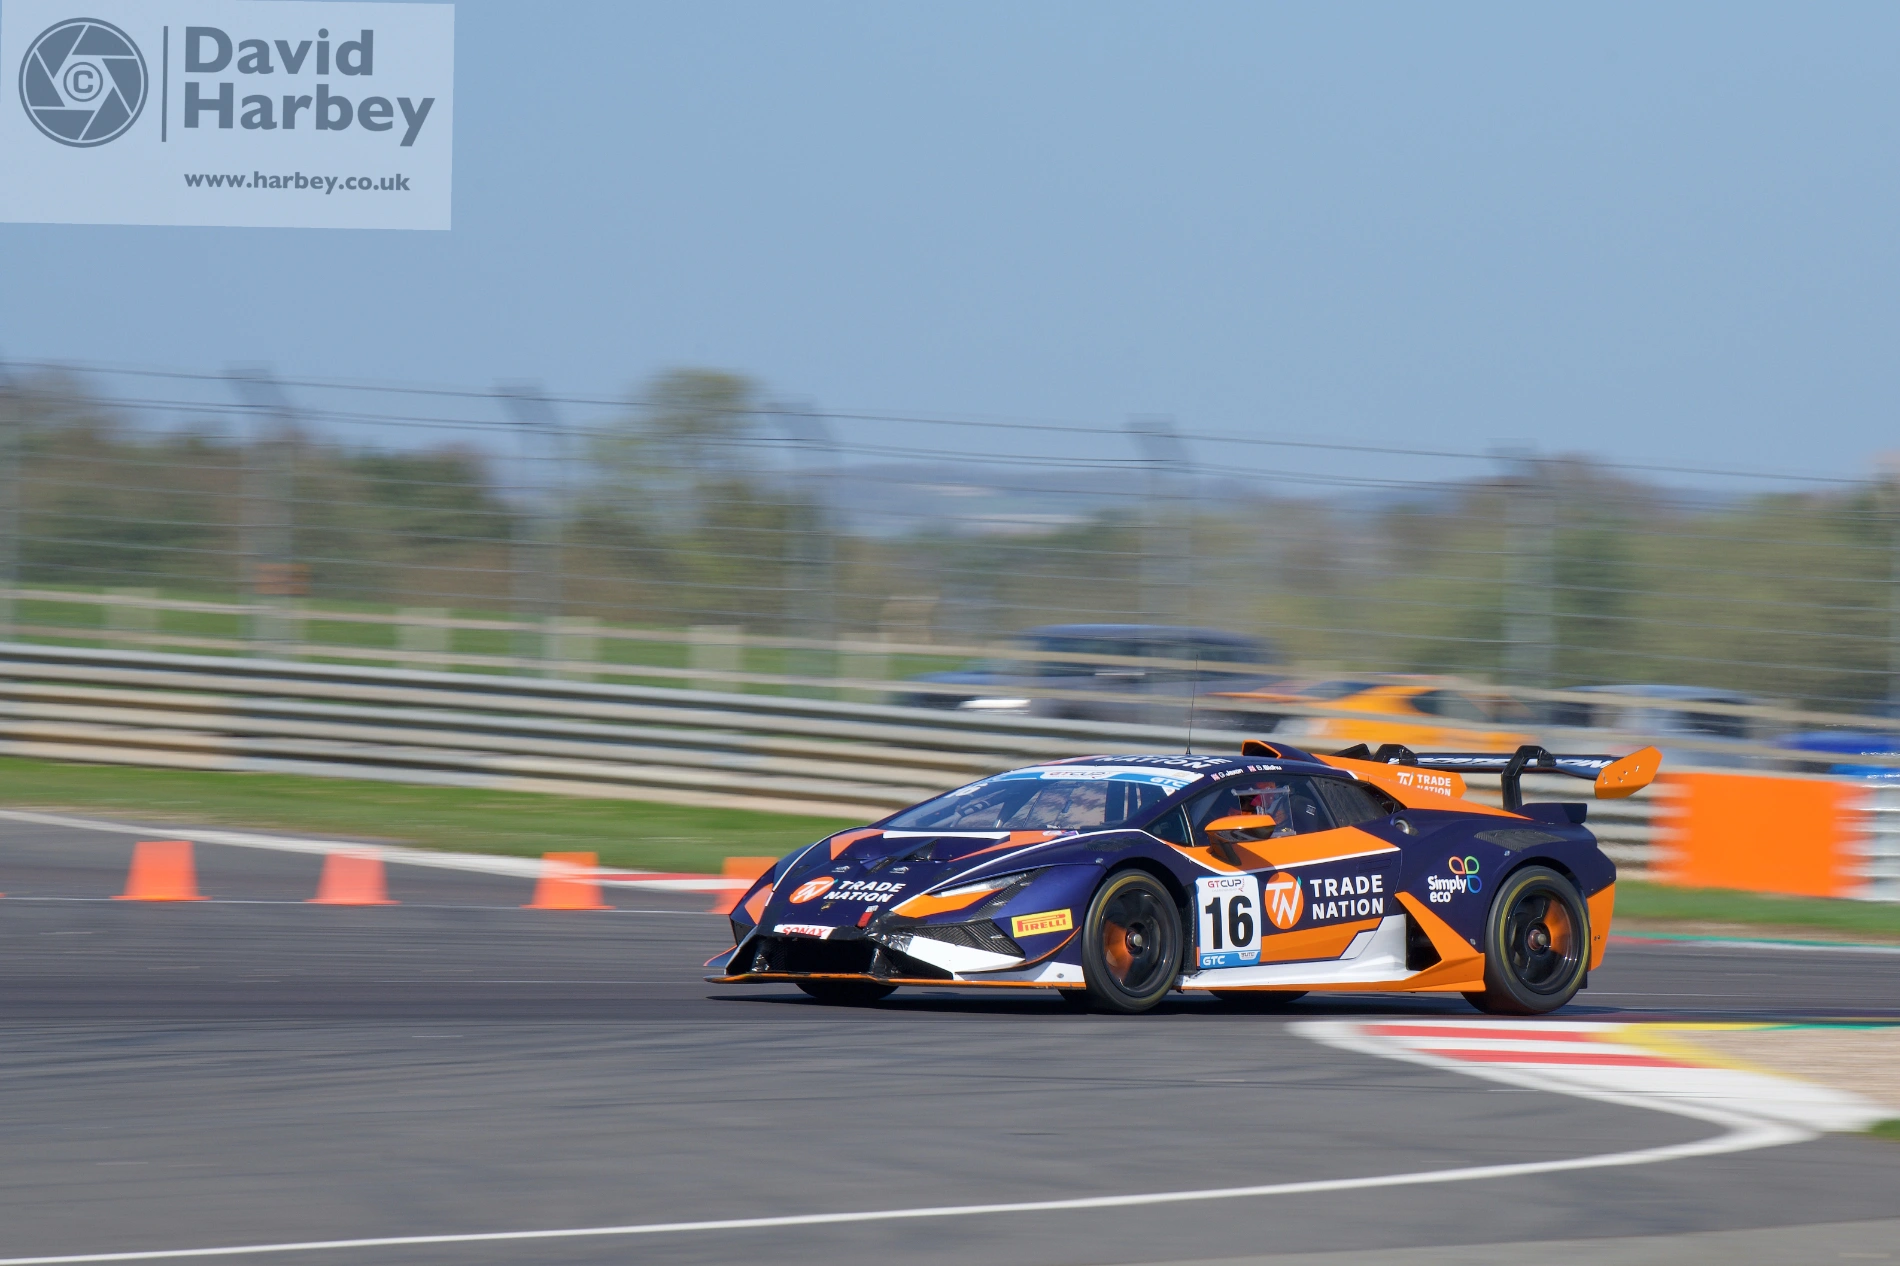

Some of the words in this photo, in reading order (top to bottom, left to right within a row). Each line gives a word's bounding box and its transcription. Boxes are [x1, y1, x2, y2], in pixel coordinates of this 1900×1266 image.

[1150, 777, 1188, 788] GTC
[1416, 774, 1452, 787] TRADE
[838, 881, 906, 892] TRADE
[1309, 874, 1384, 898] TRADE
[1427, 875, 1467, 894] Simply
[823, 891, 894, 903] NATION
[1430, 891, 1452, 903] eco
[1312, 897, 1384, 920] NATION
[1016, 914, 1068, 933] PIRELLI
[1205, 895, 1254, 950] 16
[1202, 955, 1226, 966] GTC
